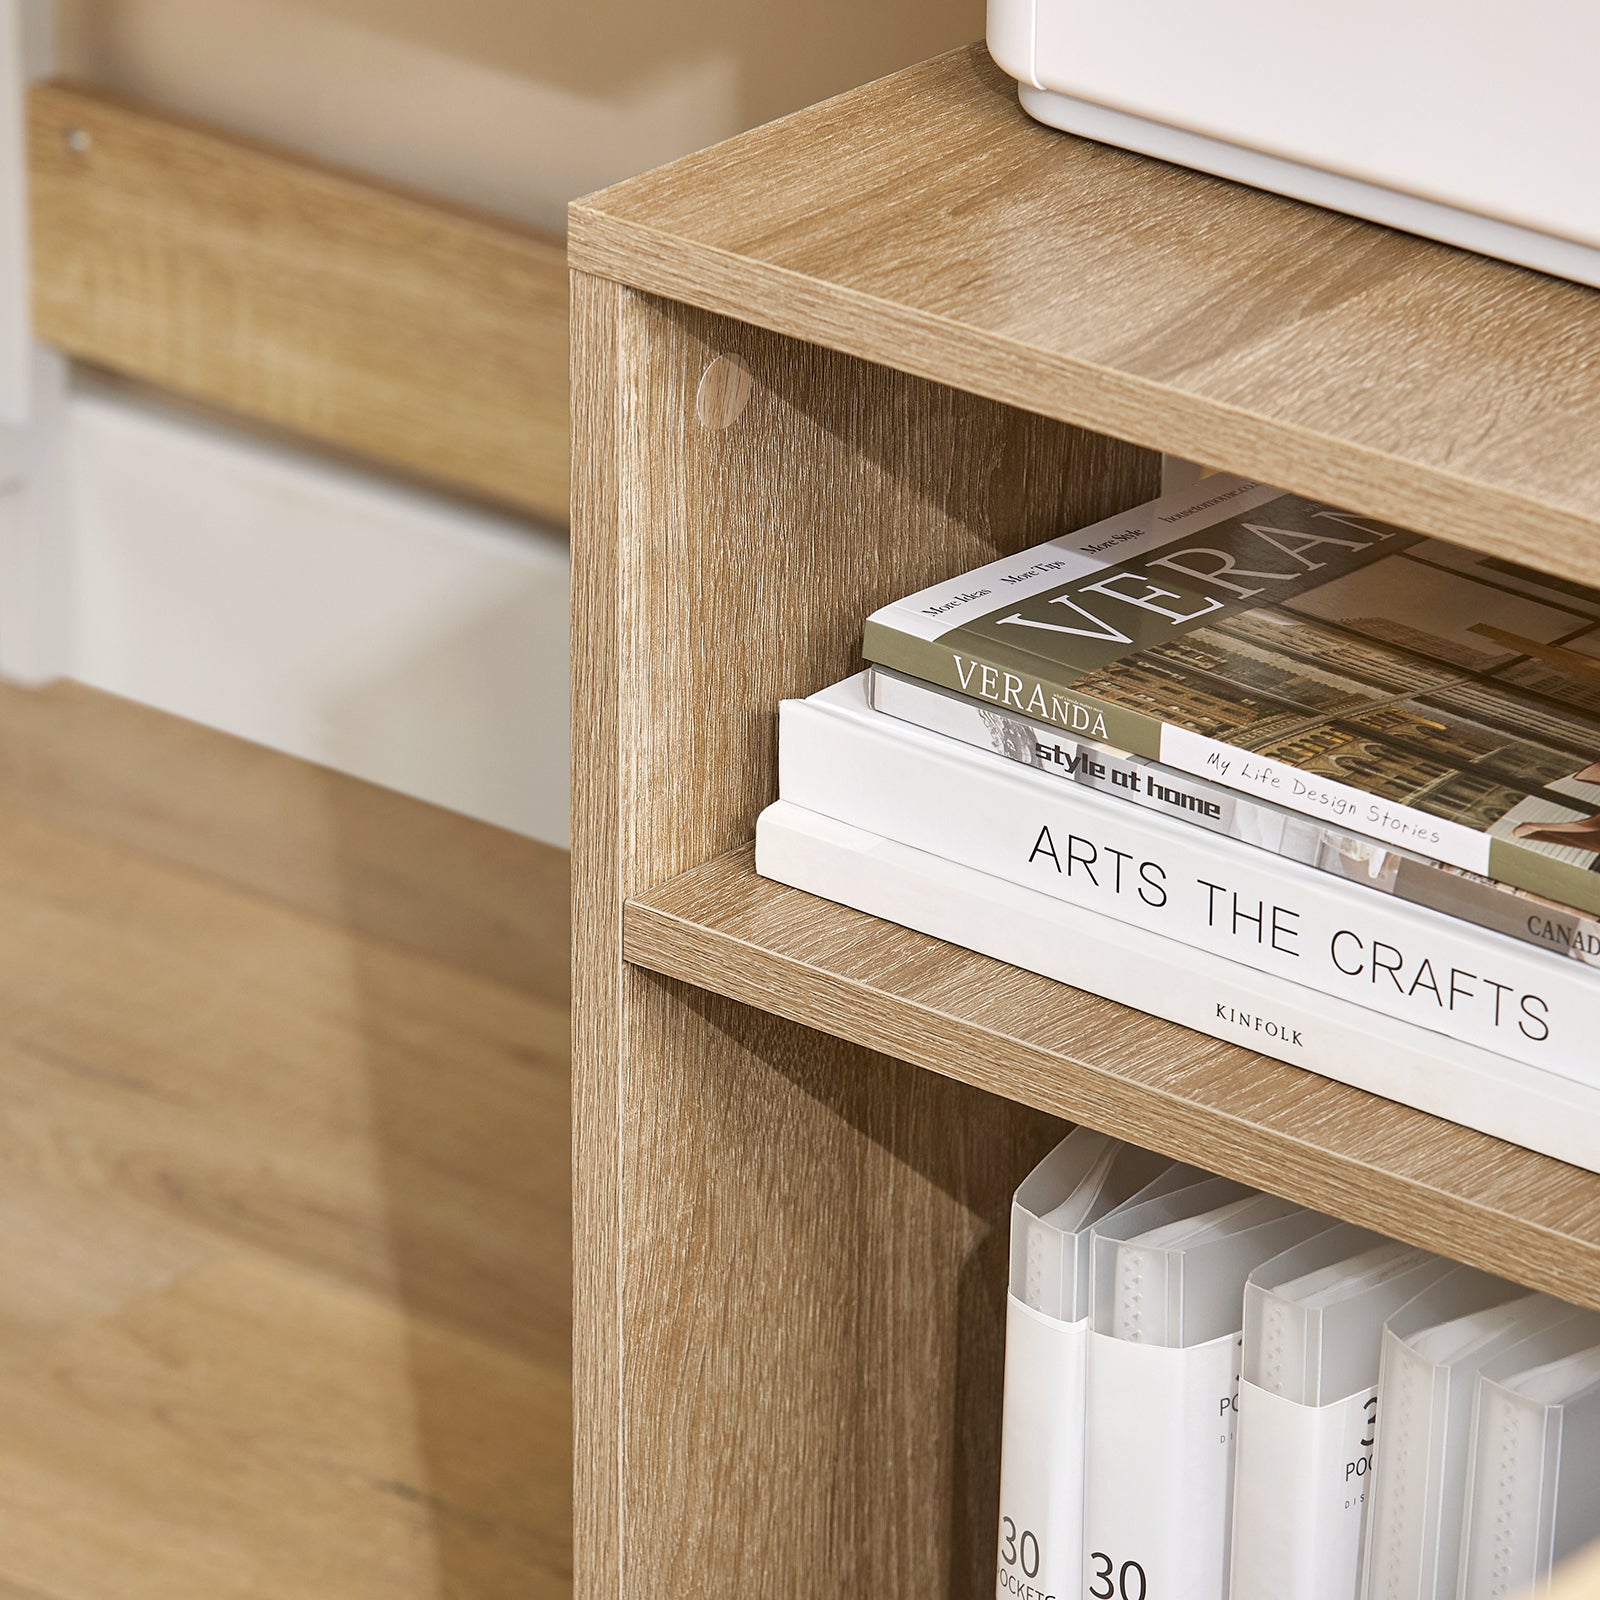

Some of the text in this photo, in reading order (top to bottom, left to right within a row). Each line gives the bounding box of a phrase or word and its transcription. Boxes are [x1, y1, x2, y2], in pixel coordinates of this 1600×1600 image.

[922, 599, 961, 617] More
[957, 587, 992, 604] Ideas
[1001, 569, 1038, 585] More
[1032, 559, 1066, 575] Tips
[1080, 538, 1116, 554] More
[1114, 528, 1145, 545] Style
[953, 654, 1109, 740] VERANDA
[1035, 742, 1221, 820] style at home
[1207, 752, 1441, 844] My Life Design Stories
[1028, 825, 1551, 1042] ARTS THE CRAFTS
[1527, 915, 1600, 956] CANAD
[1216, 1003, 1303, 1047] KINFOLK
[1001, 1516, 1040, 1579] 30
[1089, 1552, 1147, 1600] 30
